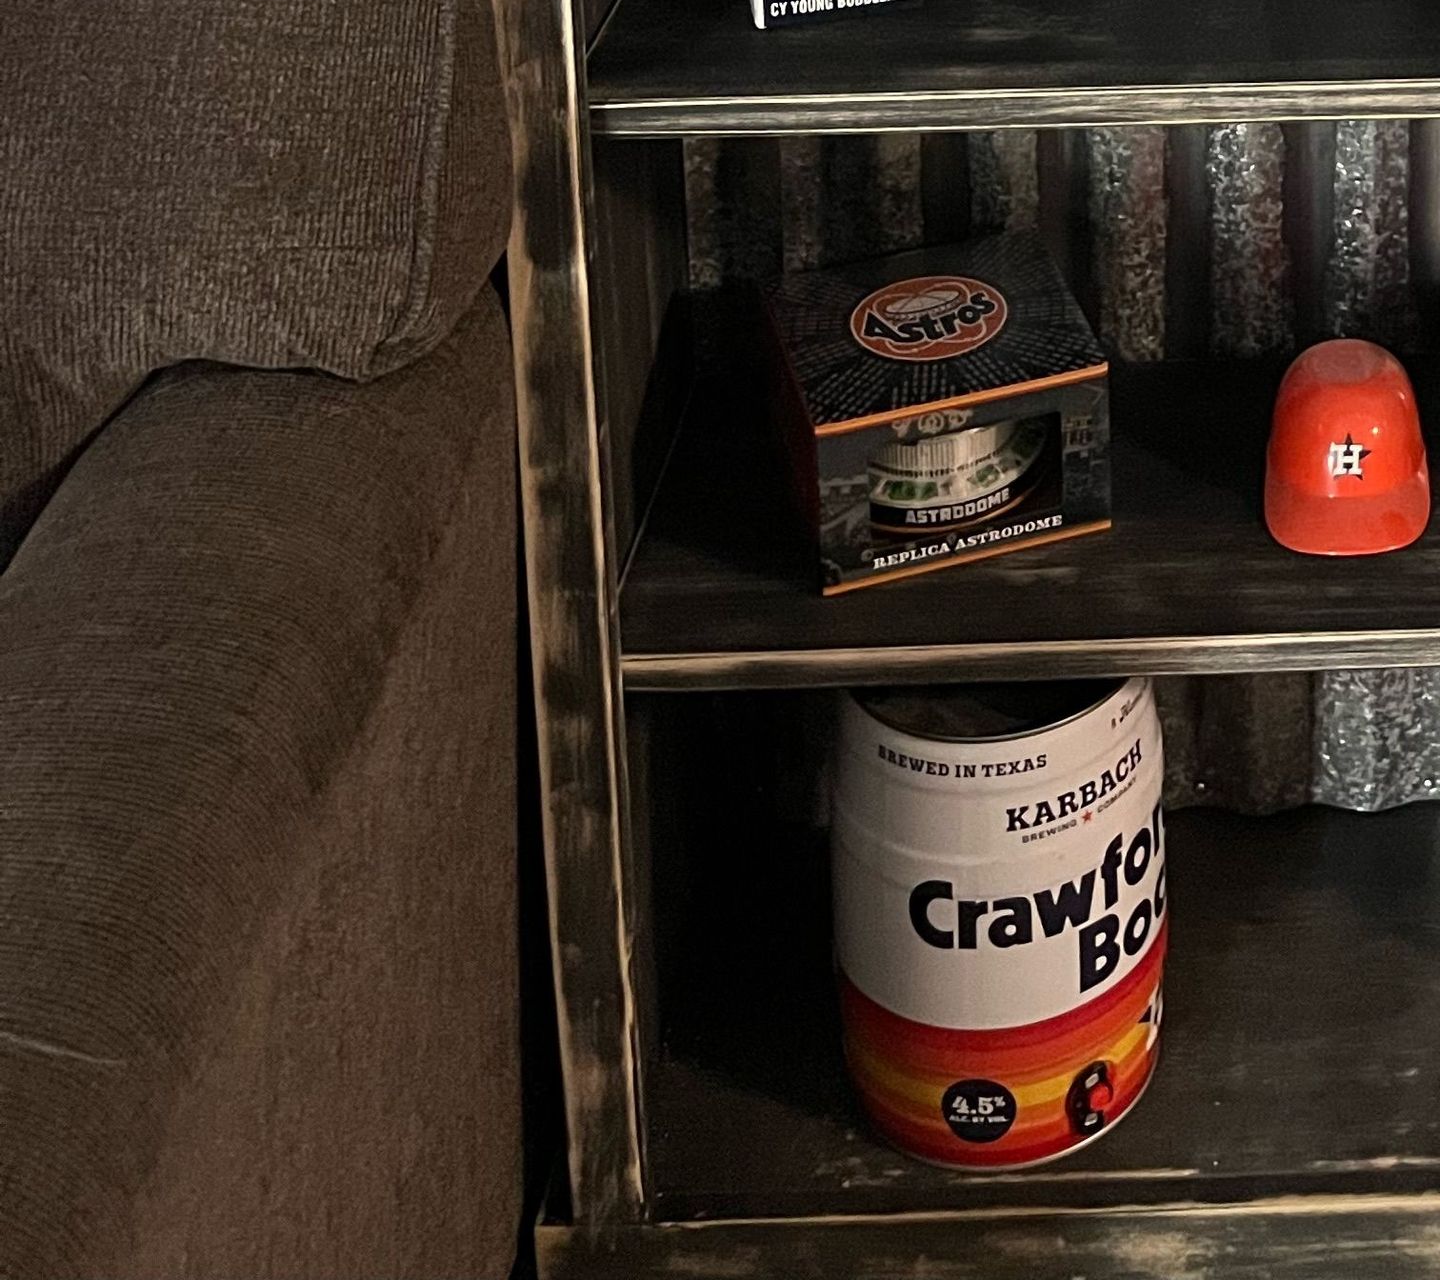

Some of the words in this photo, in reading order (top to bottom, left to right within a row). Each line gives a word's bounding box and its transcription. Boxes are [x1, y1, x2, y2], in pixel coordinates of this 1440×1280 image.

[770, 2, 788, 18] CY
[861, 290, 998, 344] Astros
[1331, 443, 1364, 476] H
[905, 488, 1010, 524] ASTRODOME
[873, 542, 951, 570] REPLICA
[955, 514, 1063, 550] ASTRODOME
[878, 744, 950, 777] BREWED
[955, 764, 976, 779] IN
[981, 754, 1048, 778] TEXAS
[1006, 738, 1142, 833] KARBACH
[1022, 819, 1077, 844] BREWING
